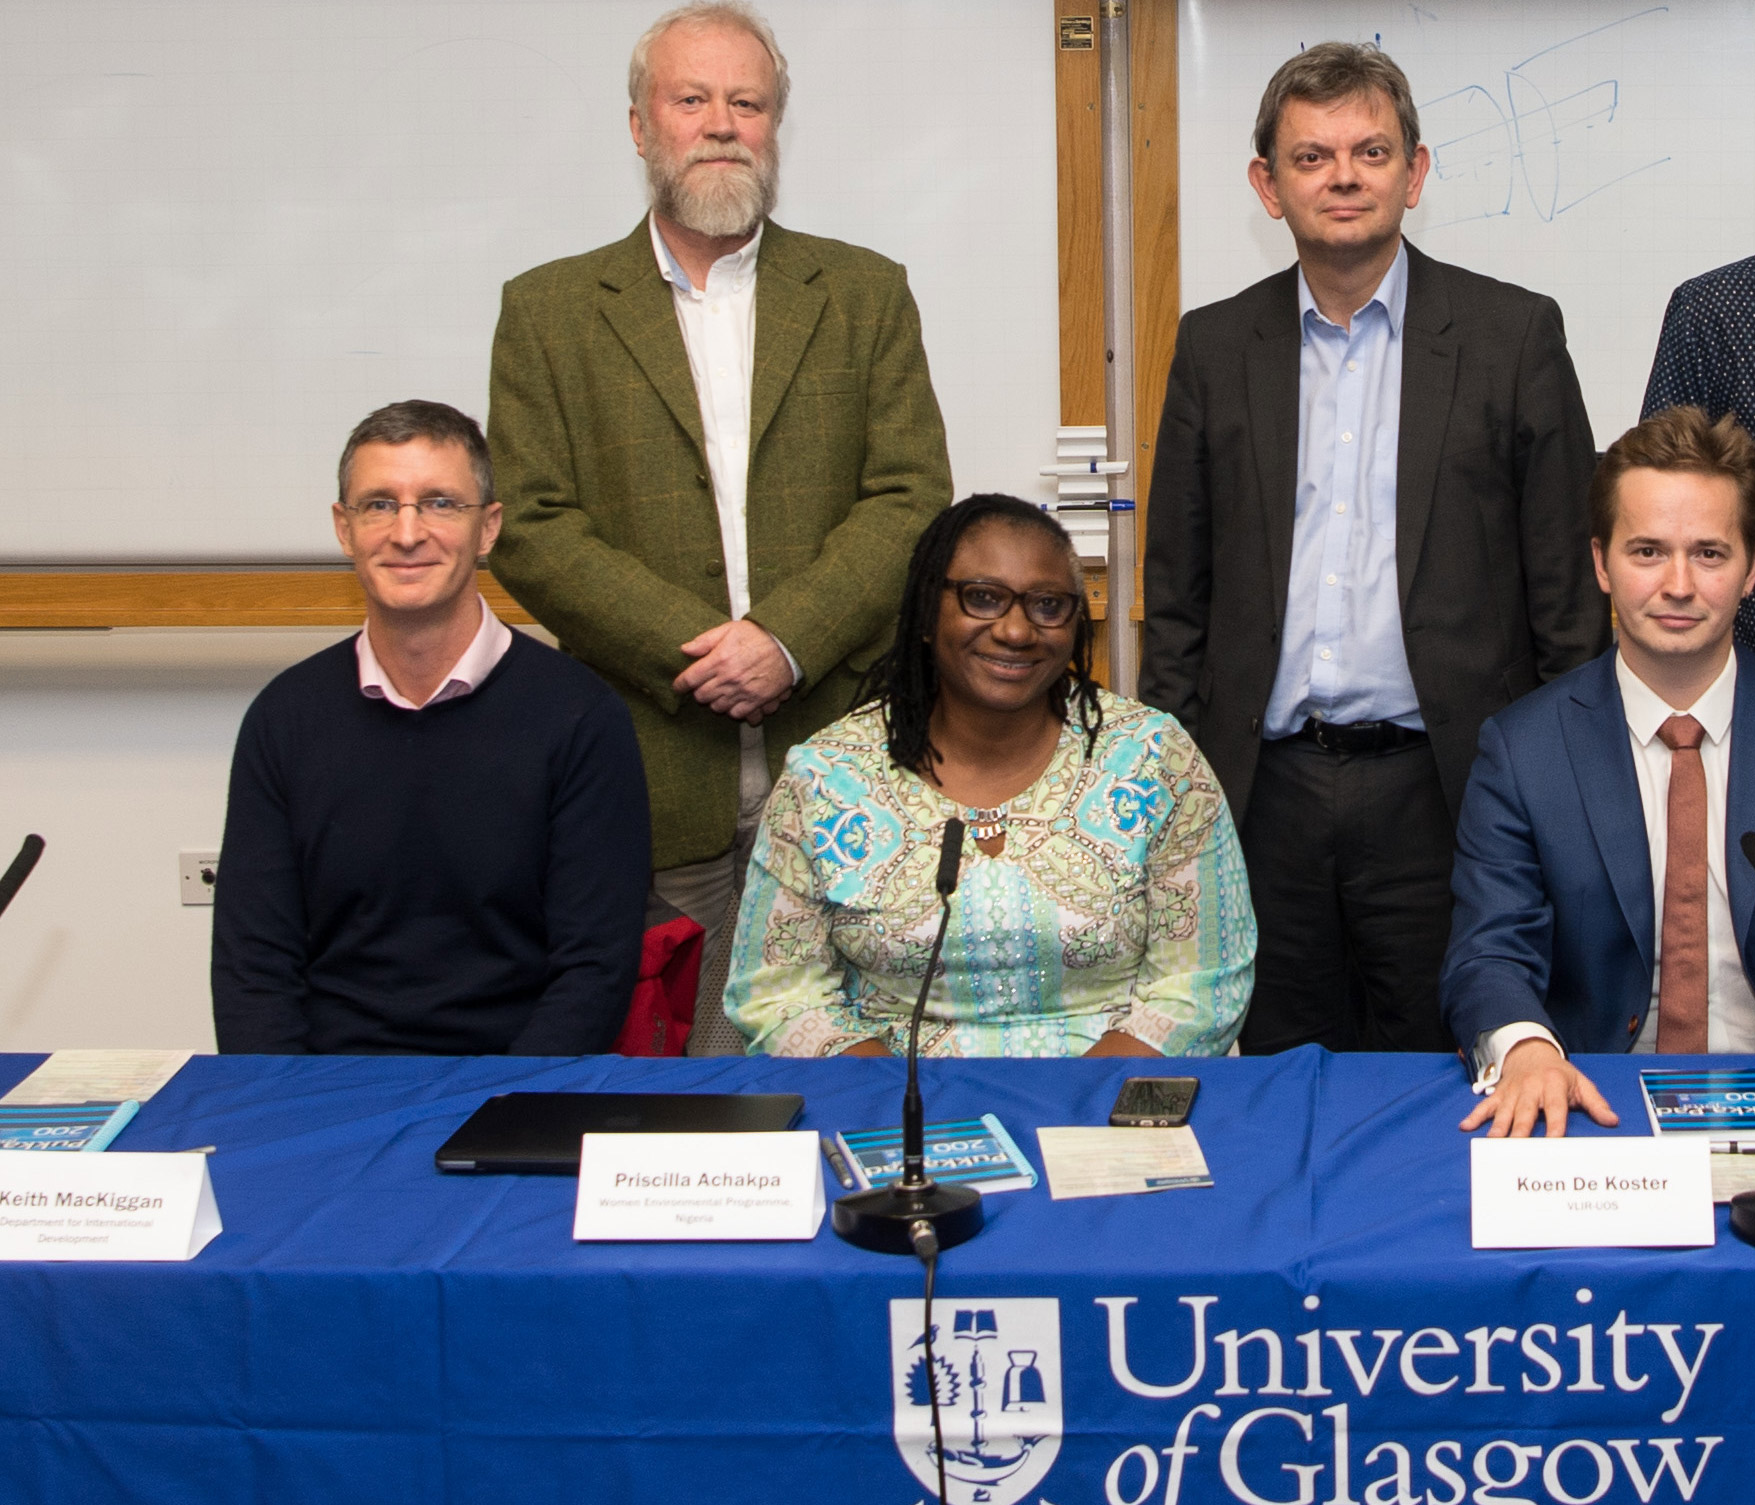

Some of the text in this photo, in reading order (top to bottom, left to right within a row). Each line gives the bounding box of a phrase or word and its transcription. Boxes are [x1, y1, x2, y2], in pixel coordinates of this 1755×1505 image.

[1656, 1106, 1704, 1117] Pad
[33, 1125, 89, 1137] 200
[932, 1138, 986, 1153] 200
[923, 1151, 1008, 1170] Pukka
[614, 1172, 782, 1190] Priscilla Achakpa
[1516, 1175, 1668, 1192] Koen De Koster
[0, 1190, 164, 1212] Keith MacKiggan
[599, 1198, 641, 1207] Women
[644, 1197, 722, 1207] Environmental
[0, 1216, 154, 1229] Department for International
[675, 1213, 714, 1224] Nigeria
[37, 1233, 110, 1245] Development
[1094, 1287, 1725, 1423] University
[1104, 1402, 1724, 1505] of Glasgow
